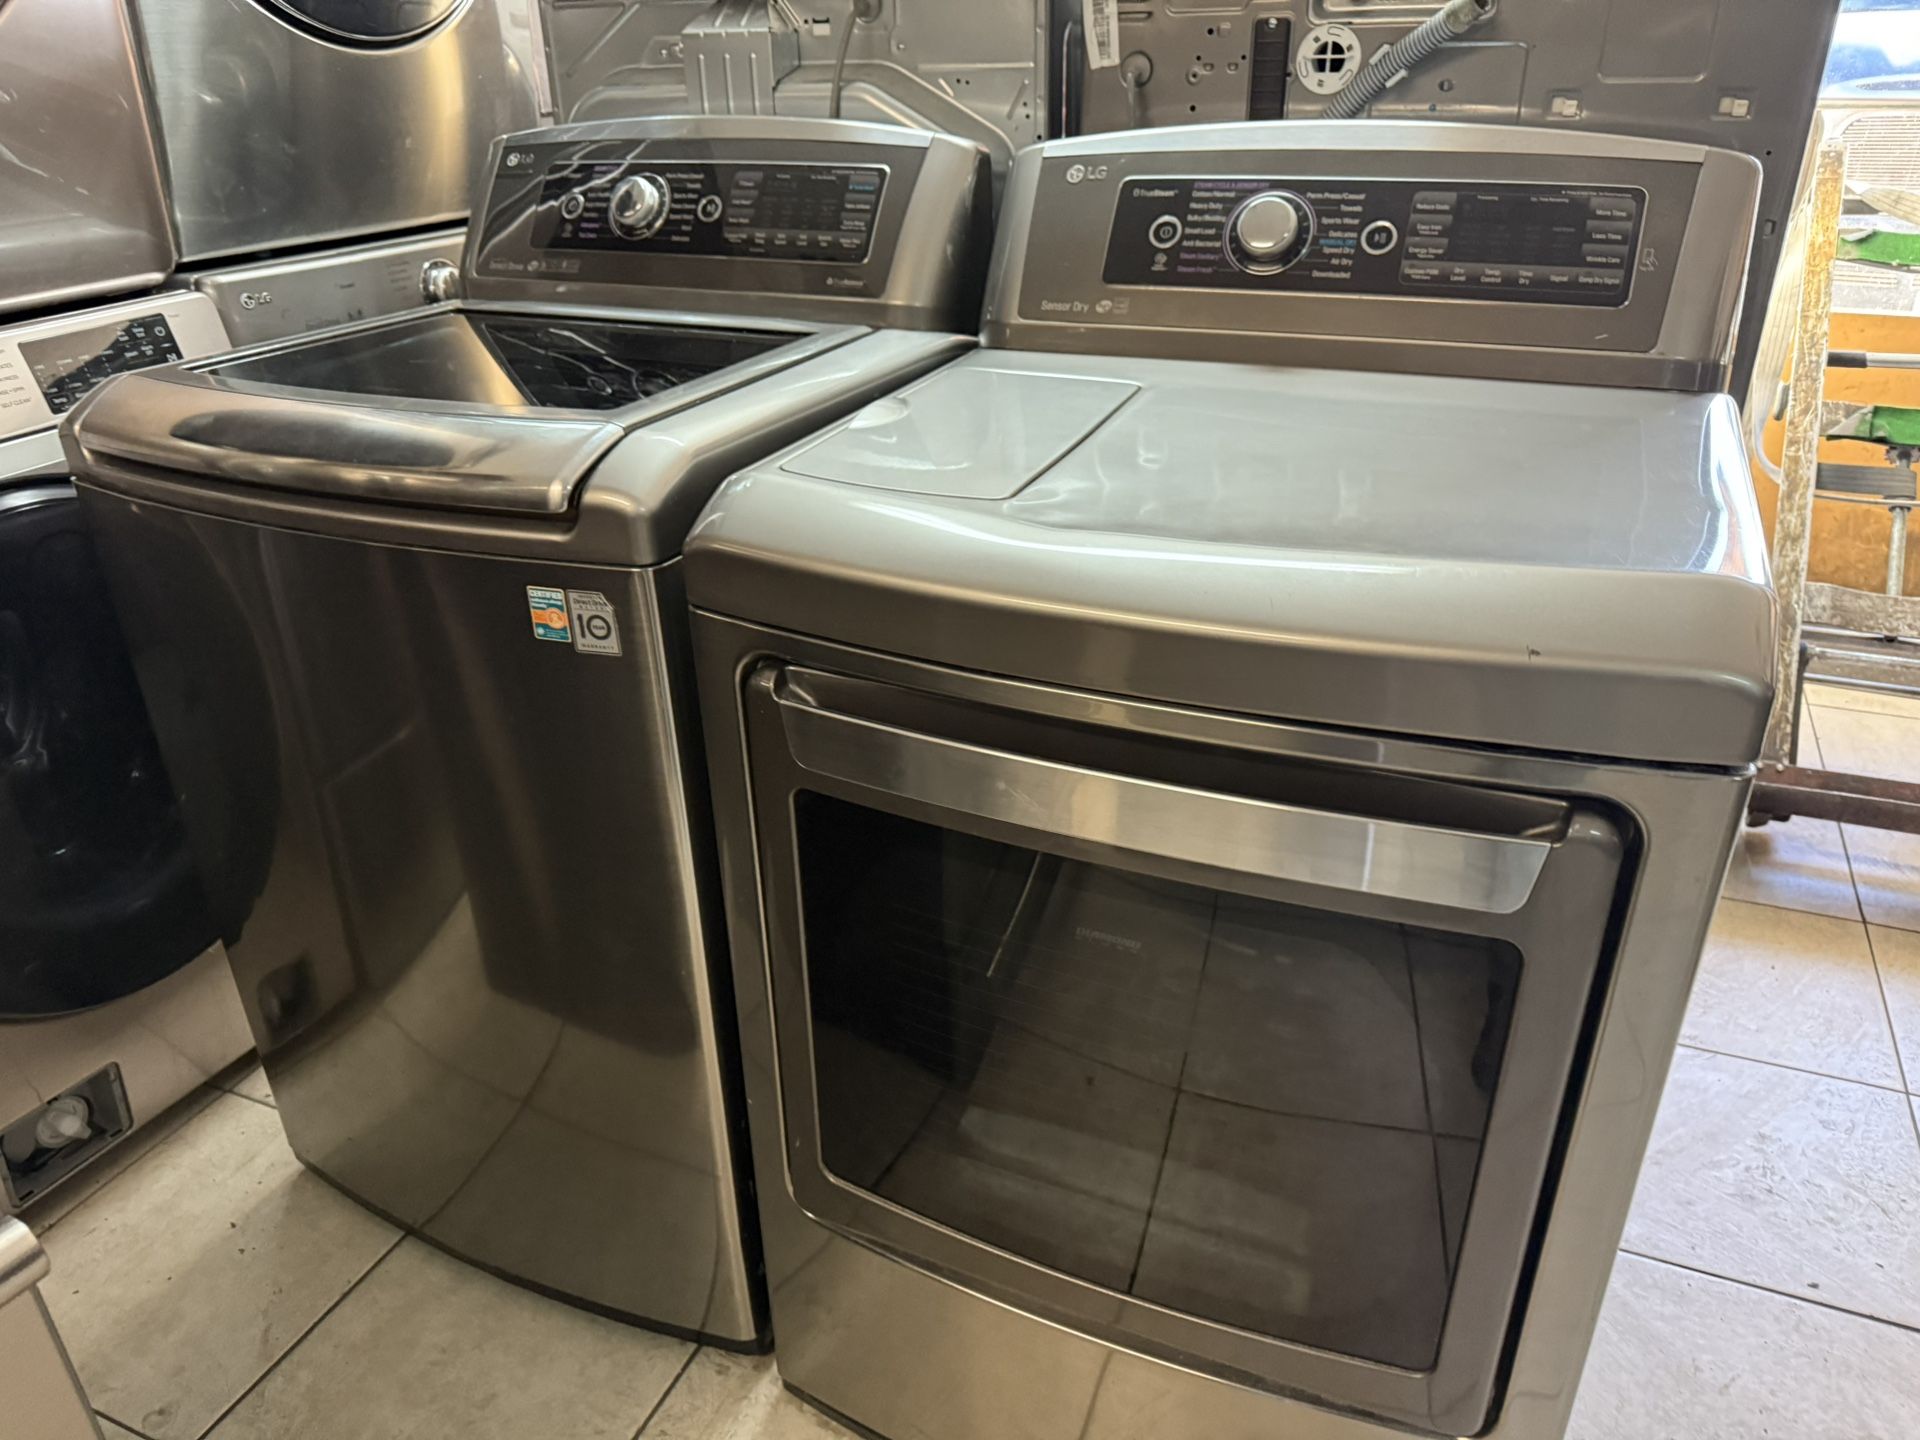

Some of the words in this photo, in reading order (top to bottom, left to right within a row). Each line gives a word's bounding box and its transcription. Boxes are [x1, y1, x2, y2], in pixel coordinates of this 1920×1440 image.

[1087, 165, 1108, 179] LG
[1041, 299, 1072, 311] Sensor
[1072, 301, 1089, 313] Dry
[577, 613, 612, 641] 10
